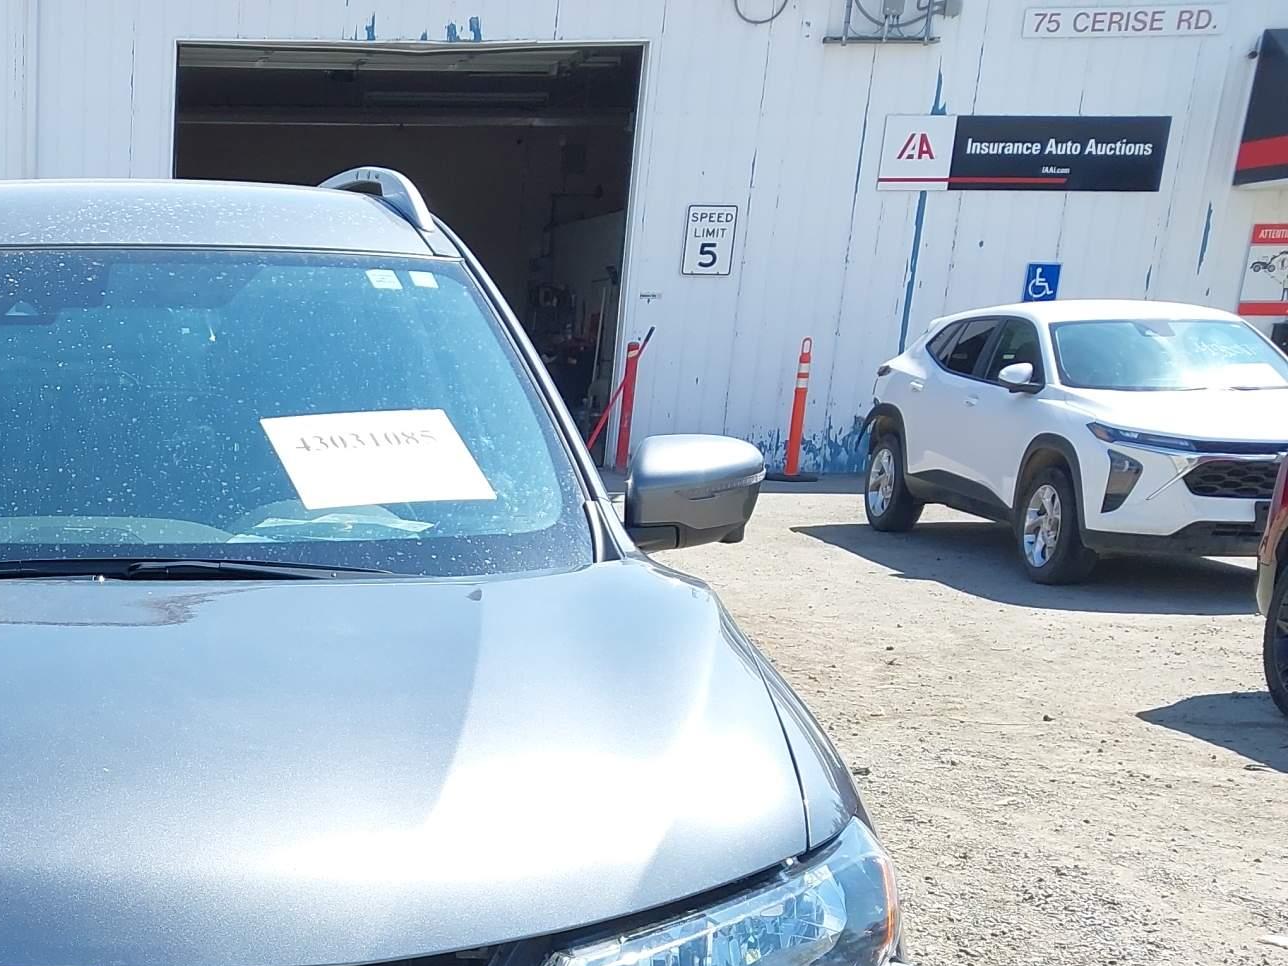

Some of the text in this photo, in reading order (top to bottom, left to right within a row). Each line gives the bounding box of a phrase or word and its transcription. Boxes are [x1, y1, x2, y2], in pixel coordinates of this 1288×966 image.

[1034, 9, 1217, 33] 75 CERISE RD.
[966, 138, 1153, 156] Insurance Auto Auctions
[691, 212, 734, 223] SPEED
[694, 228, 728, 238] LIMIT
[698, 242, 717, 268] 5
